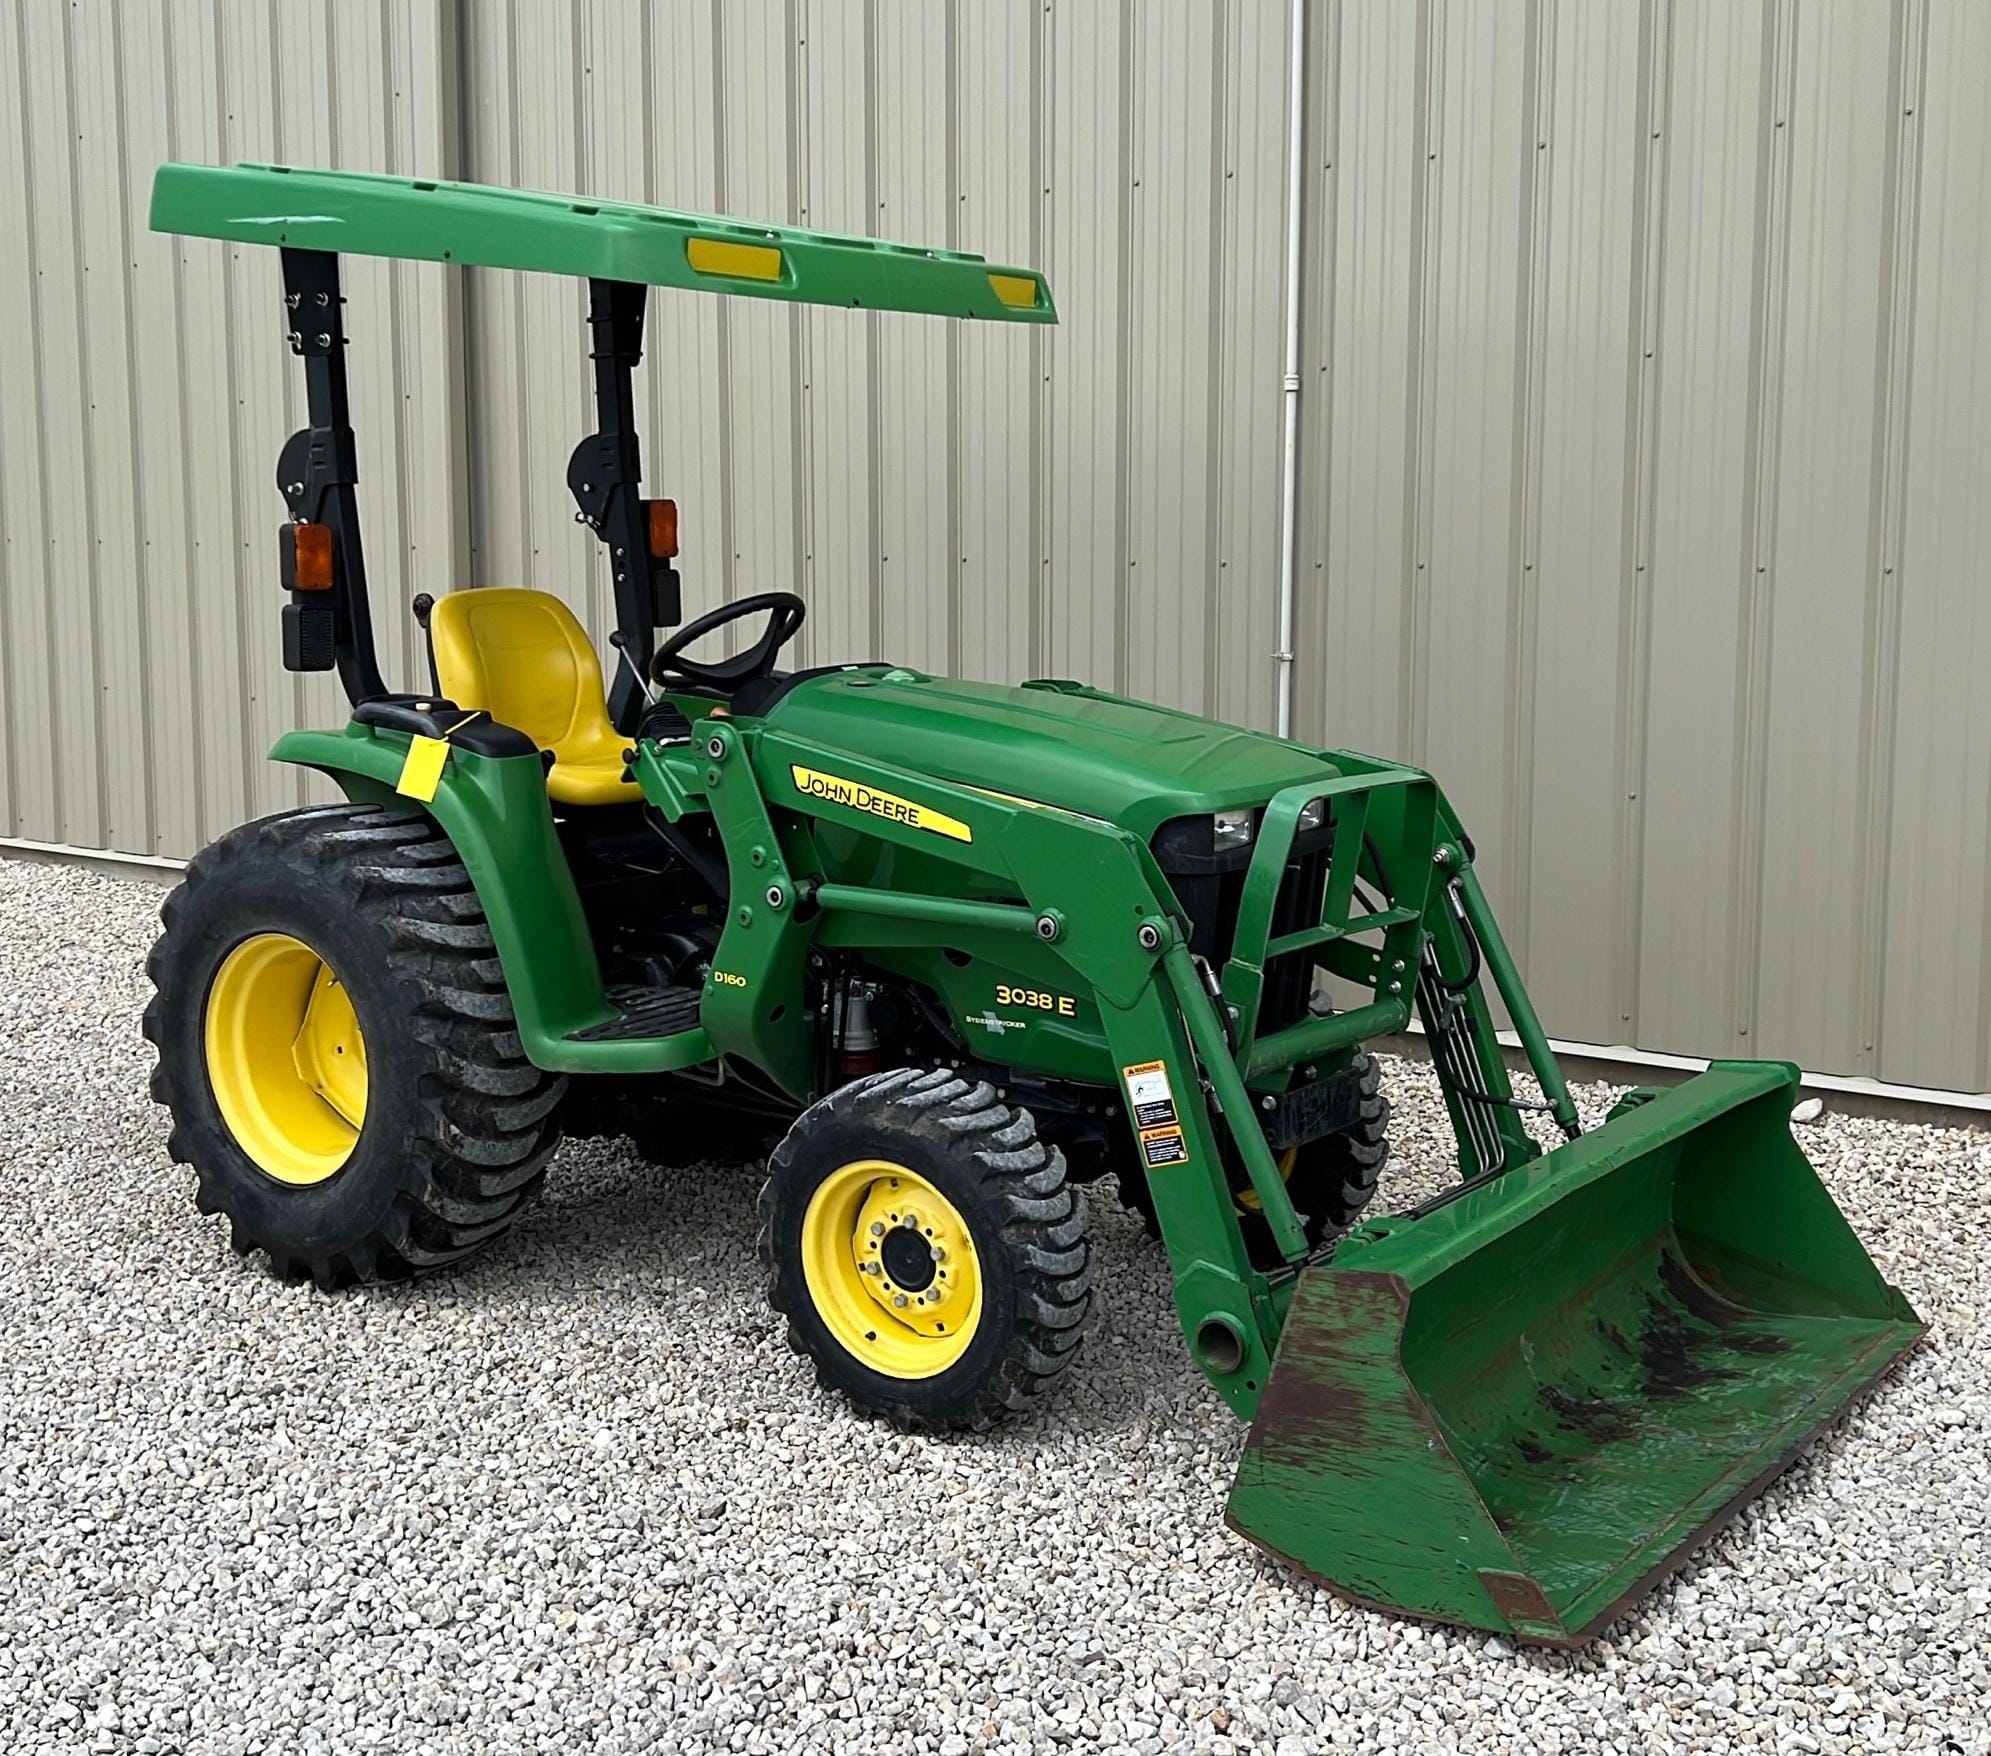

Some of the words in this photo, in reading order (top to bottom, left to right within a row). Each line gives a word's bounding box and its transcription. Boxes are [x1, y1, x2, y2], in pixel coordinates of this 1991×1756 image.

[800, 773, 852, 803] JOHN
[856, 787, 920, 825] DEERE
[714, 971, 747, 987] D160
[996, 985, 1053, 1010] 3038
[1058, 995, 1076, 1016] E
[1134, 1063, 1160, 1073] WARNING
